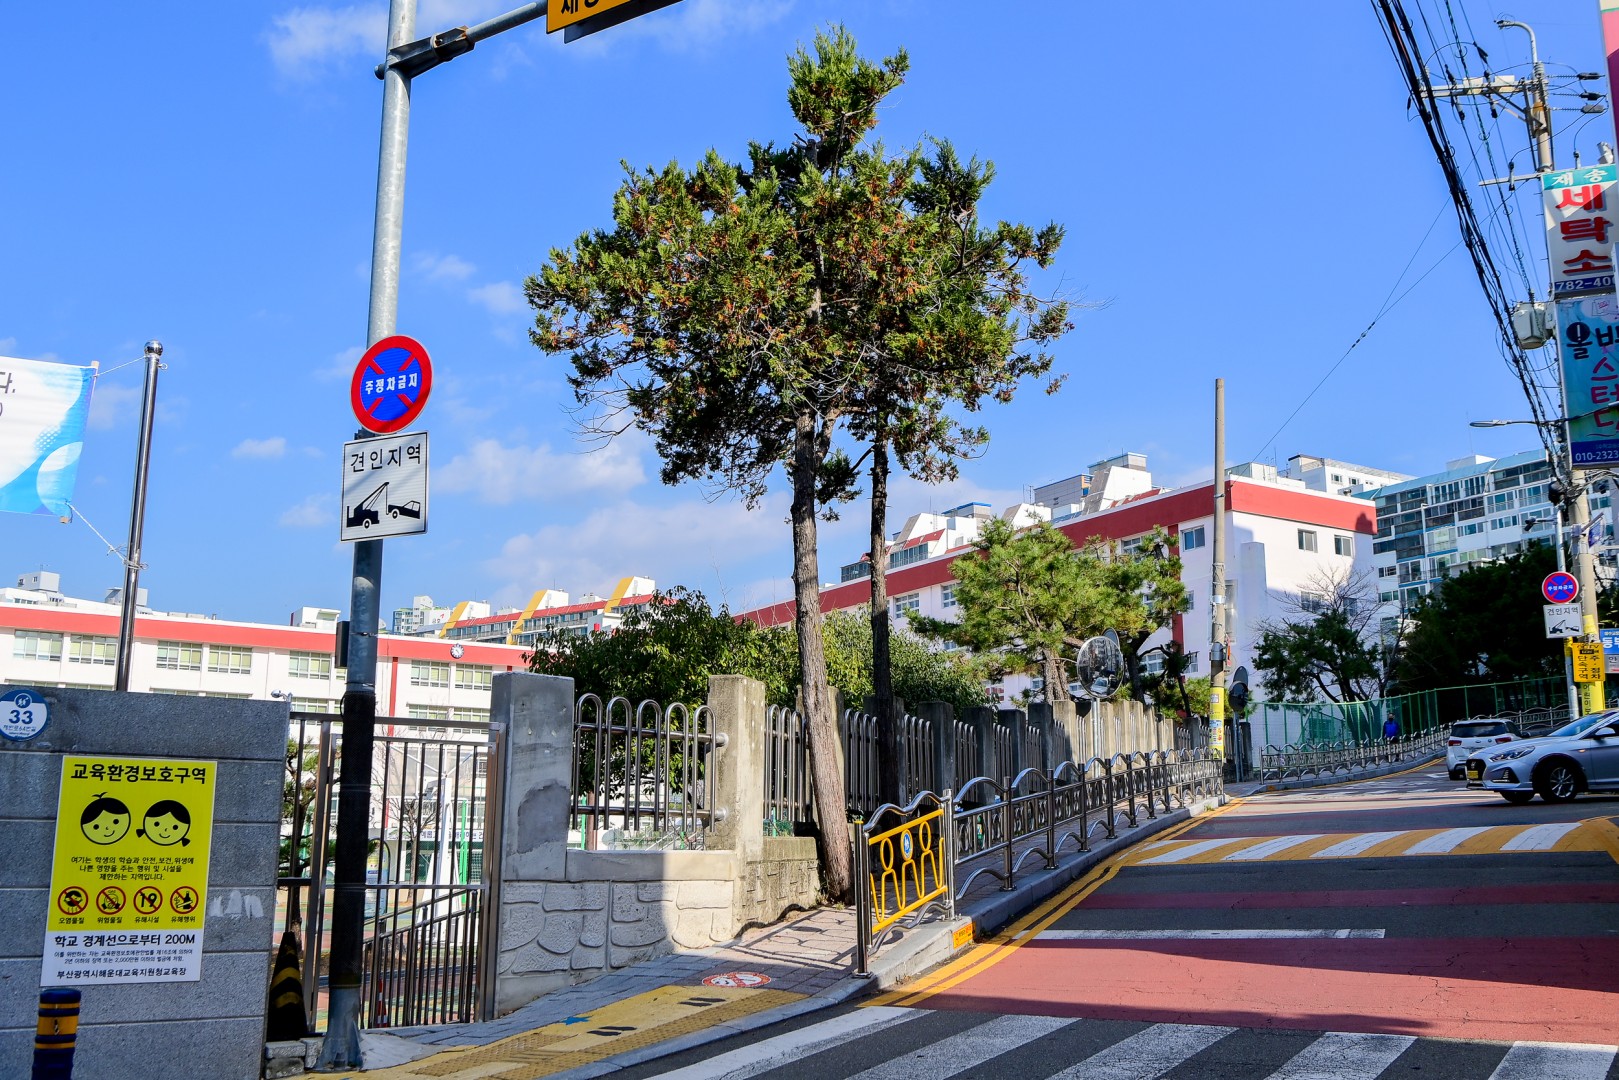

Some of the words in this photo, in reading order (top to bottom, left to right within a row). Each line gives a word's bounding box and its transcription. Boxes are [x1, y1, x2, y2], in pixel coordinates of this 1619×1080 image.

[1555, 184, 1612, 274] 세탁소
[365, 373, 418, 395] 주정차금지
[351, 443, 421, 472] 견인지역
[1547, 606, 1579, 616] 견인지역
[8, 709, 33, 725] 33
[71, 764, 206, 784] 교육환경보호구역
[71, 856, 92, 864] 여기는
[95, 856, 116, 864] 학생의
[119, 856, 140, 864] 학습과
[97, 865, 117, 873] 영향을
[137, 865, 151, 873] 행위
[162, 865, 182, 873] 시설을
[140, 893, 157, 907] 19
[97, 916, 123, 924] 위험물질
[134, 916, 159, 924] 유해시설
[55, 935, 78, 948] 학교
[83, 934, 160, 947] 경계선으로부터
[164, 934, 195, 944] 200M
[56, 967, 187, 980] 부산광역시해운대교육지원청교육장
